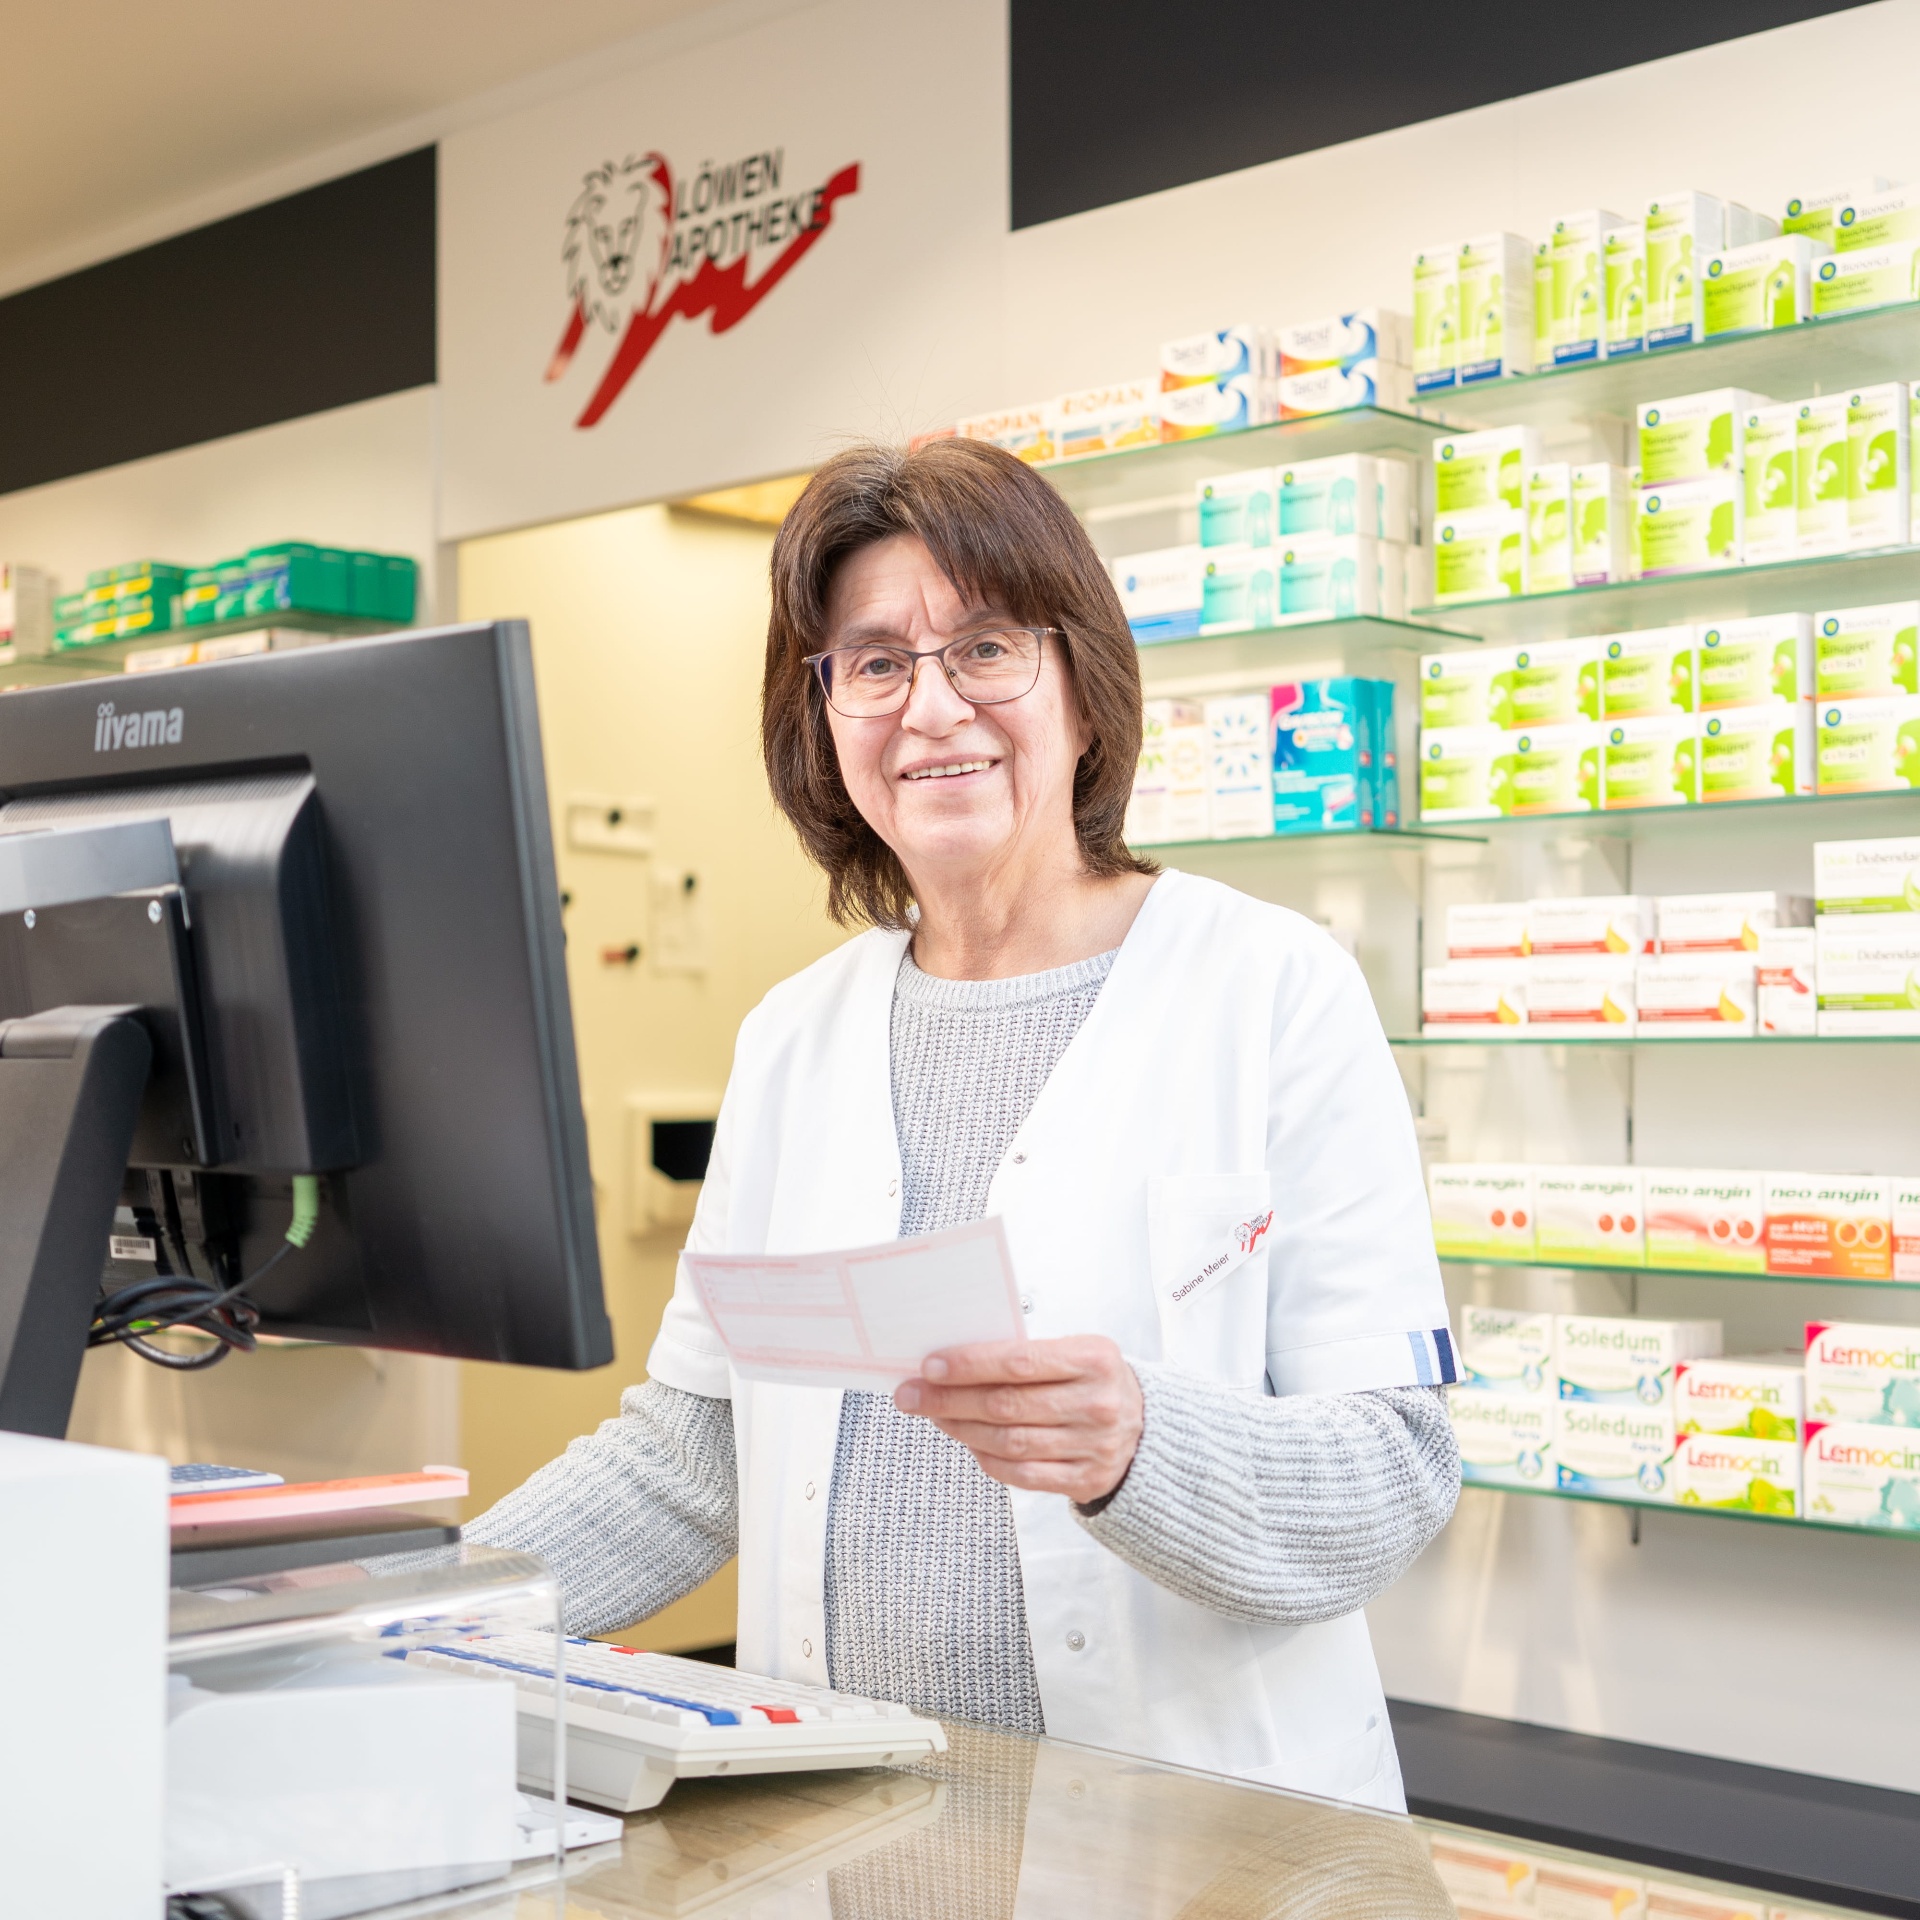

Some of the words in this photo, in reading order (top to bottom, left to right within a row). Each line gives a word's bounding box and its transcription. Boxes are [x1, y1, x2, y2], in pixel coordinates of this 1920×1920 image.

[674, 146, 784, 221] LÖWEN
[667, 186, 827, 273] APOTHEKE
[1062, 386, 1144, 416] RIOPAN
[94, 702, 184, 752] iiyama
[1434, 1176, 1470, 1187] neo
[1473, 1177, 1525, 1192] angin
[1540, 1180, 1576, 1191] neo
[1580, 1181, 1634, 1195] angin
[1650, 1185, 1688, 1196] neo
[1693, 1186, 1751, 1200] angin
[1771, 1186, 1812, 1198] neo
[1817, 1188, 1880, 1203] angin
[1172, 1274, 1205, 1301] Sabine
[1203, 1253, 1230, 1276] Meier
[1468, 1311, 1543, 1340] Soledum
[1564, 1322, 1662, 1351] Soledum
[1687, 1376, 1781, 1404] Lemocin
[1449, 1398, 1543, 1427] Soledum
[1564, 1409, 1664, 1440] Soledum
[1687, 1445, 1781, 1475] Lemocin
